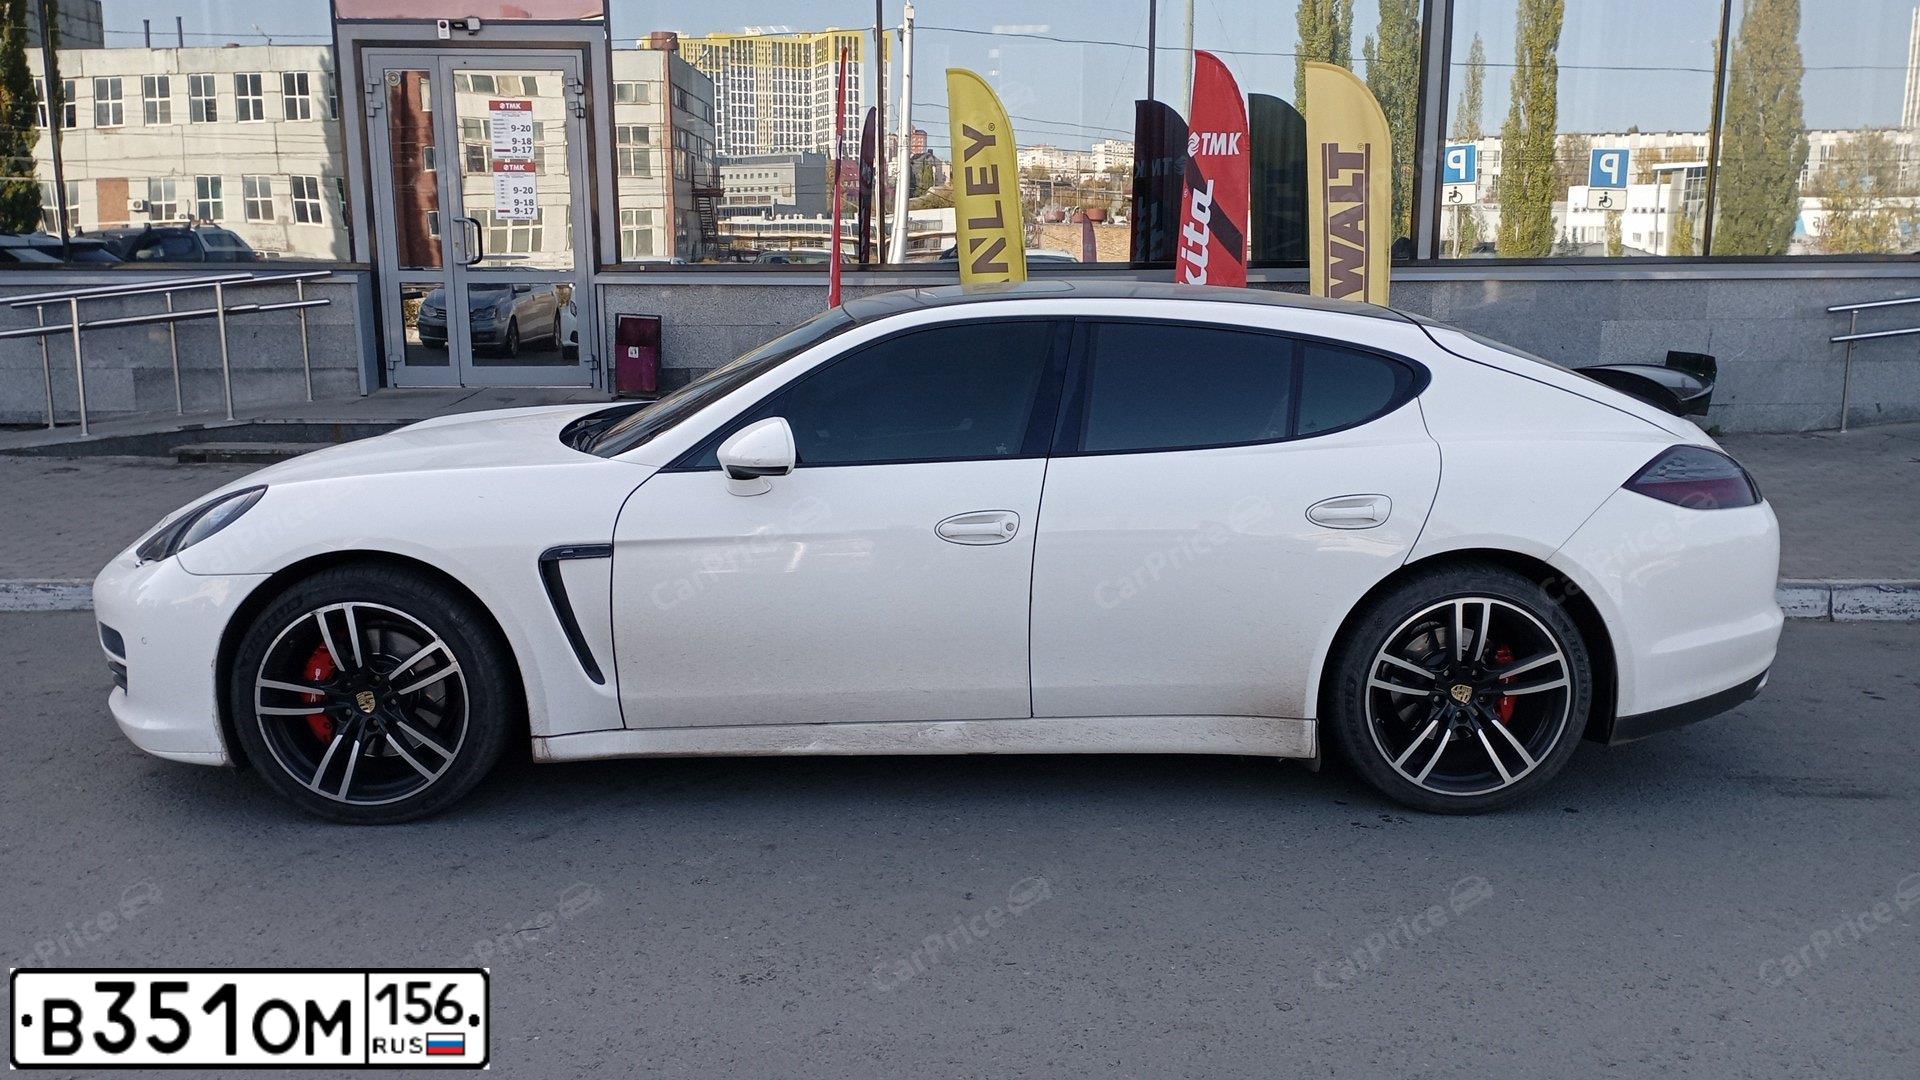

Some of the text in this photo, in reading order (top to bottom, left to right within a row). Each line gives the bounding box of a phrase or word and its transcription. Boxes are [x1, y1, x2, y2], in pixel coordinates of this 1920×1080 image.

[505, 102, 522, 110] TMK
[511, 124, 531, 132] 9-20
[1201, 132, 1242, 156] TMK
[962, 123, 1009, 282] NLEY
[515, 207, 534, 215] 9-17
[1328, 143, 1364, 299] WALT
